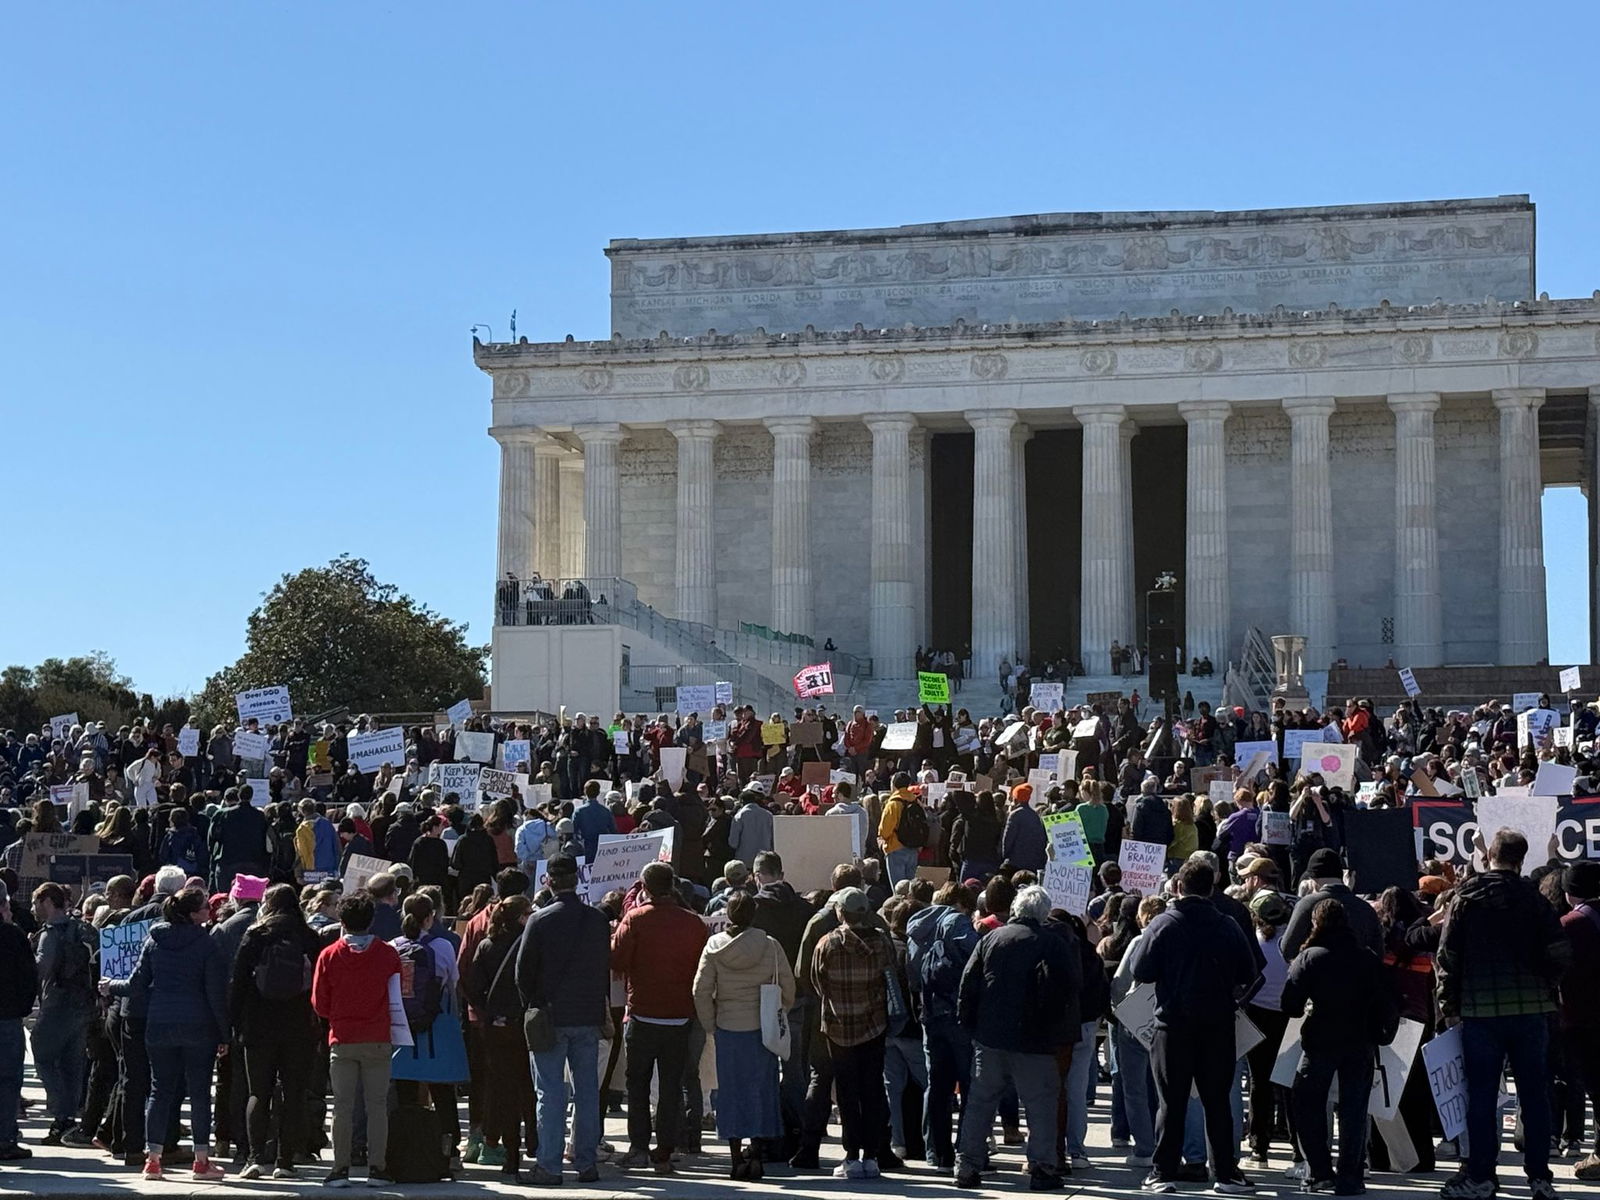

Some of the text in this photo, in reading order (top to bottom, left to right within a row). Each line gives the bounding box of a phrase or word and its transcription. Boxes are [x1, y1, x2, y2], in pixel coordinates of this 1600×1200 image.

[1255, 270, 1292, 281] NEVADA
[742, 293, 781, 303] FLORIDA
[836, 289, 863, 299] IOWA
[874, 287, 930, 297] WISCONSIN
[686, 295, 733, 305] MICHIGAN
[350, 743, 403, 760] #MAHAKILLS
[482, 769, 514, 782] STAND
[479, 782, 512, 795] SCIENCE
[1055, 830, 1077, 839] SCIENCE
[1428, 818, 1600, 862] SCCE
[597, 842, 653, 857] FUND SCIENCE
[1125, 842, 1162, 854] USE YOUR
[613, 859, 630, 867] NOT
[1131, 863, 1151, 871] FUND
[590, 870, 640, 884] BILLIONAIRE
[1049, 863, 1090, 882] WOMEN
[102, 920, 150, 948] SCIEN
[103, 954, 139, 976] AMER
[1430, 1055, 1465, 1097] EOPLE
